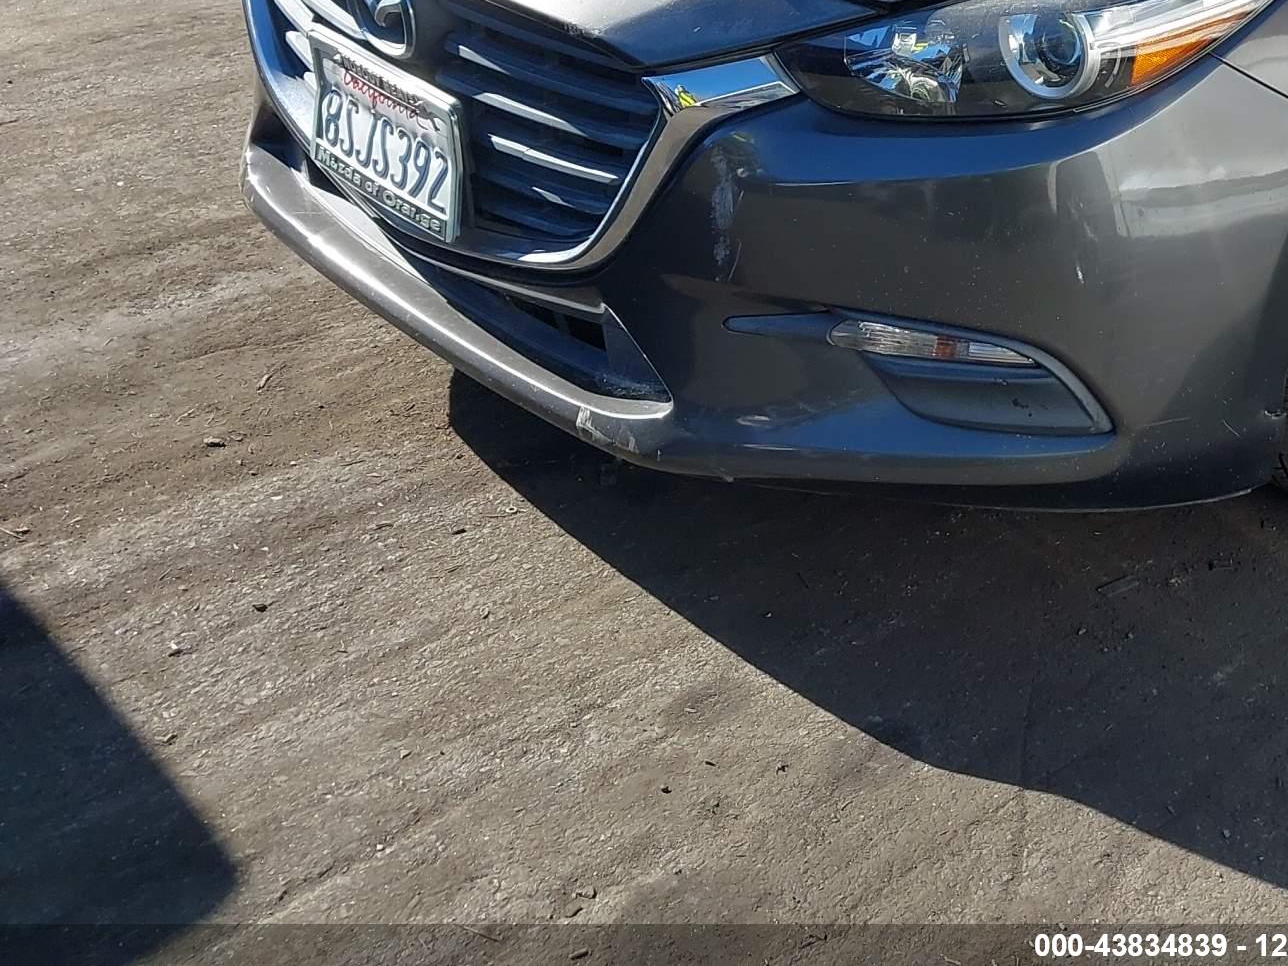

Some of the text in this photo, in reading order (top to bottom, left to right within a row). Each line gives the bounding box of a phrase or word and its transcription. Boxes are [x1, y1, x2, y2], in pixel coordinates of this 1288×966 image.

[317, 146, 442, 232] Mazda of Orange
[322, 89, 449, 213] 8SJS392
